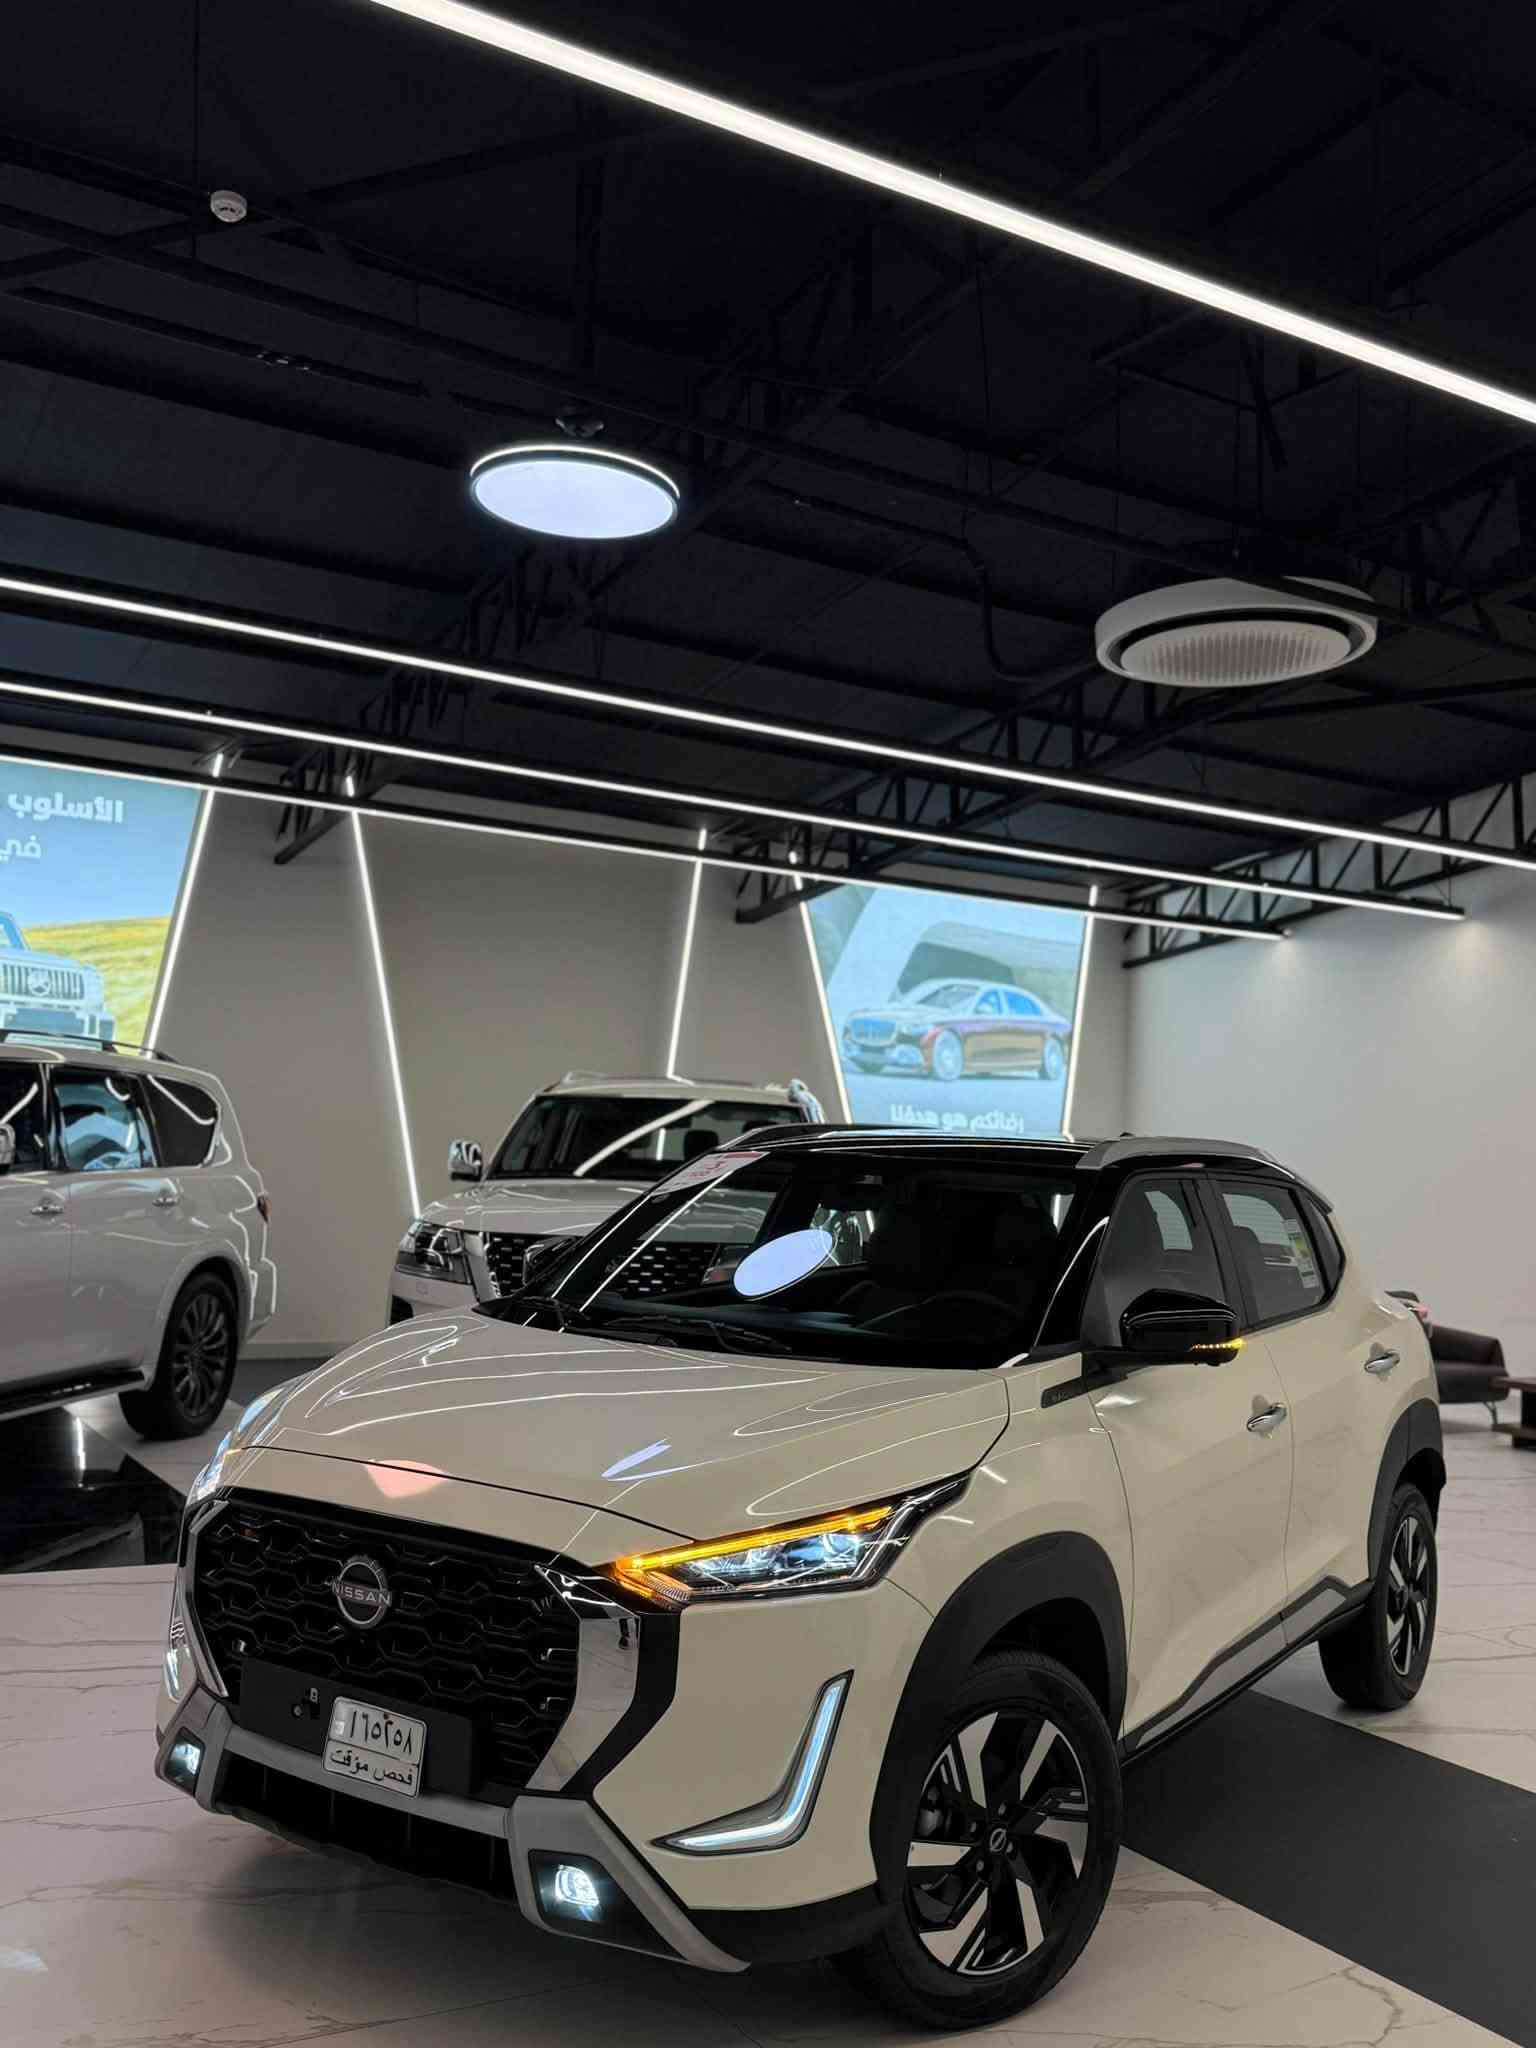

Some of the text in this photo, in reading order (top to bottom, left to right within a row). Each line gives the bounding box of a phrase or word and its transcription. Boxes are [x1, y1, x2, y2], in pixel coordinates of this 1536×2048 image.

[7, 791, 124, 824] الأسلوب
[941, 1112, 970, 1131] هو
[330, 1580, 391, 1606] NISSAN
[330, 1749, 413, 1786] فحص مؤقت
